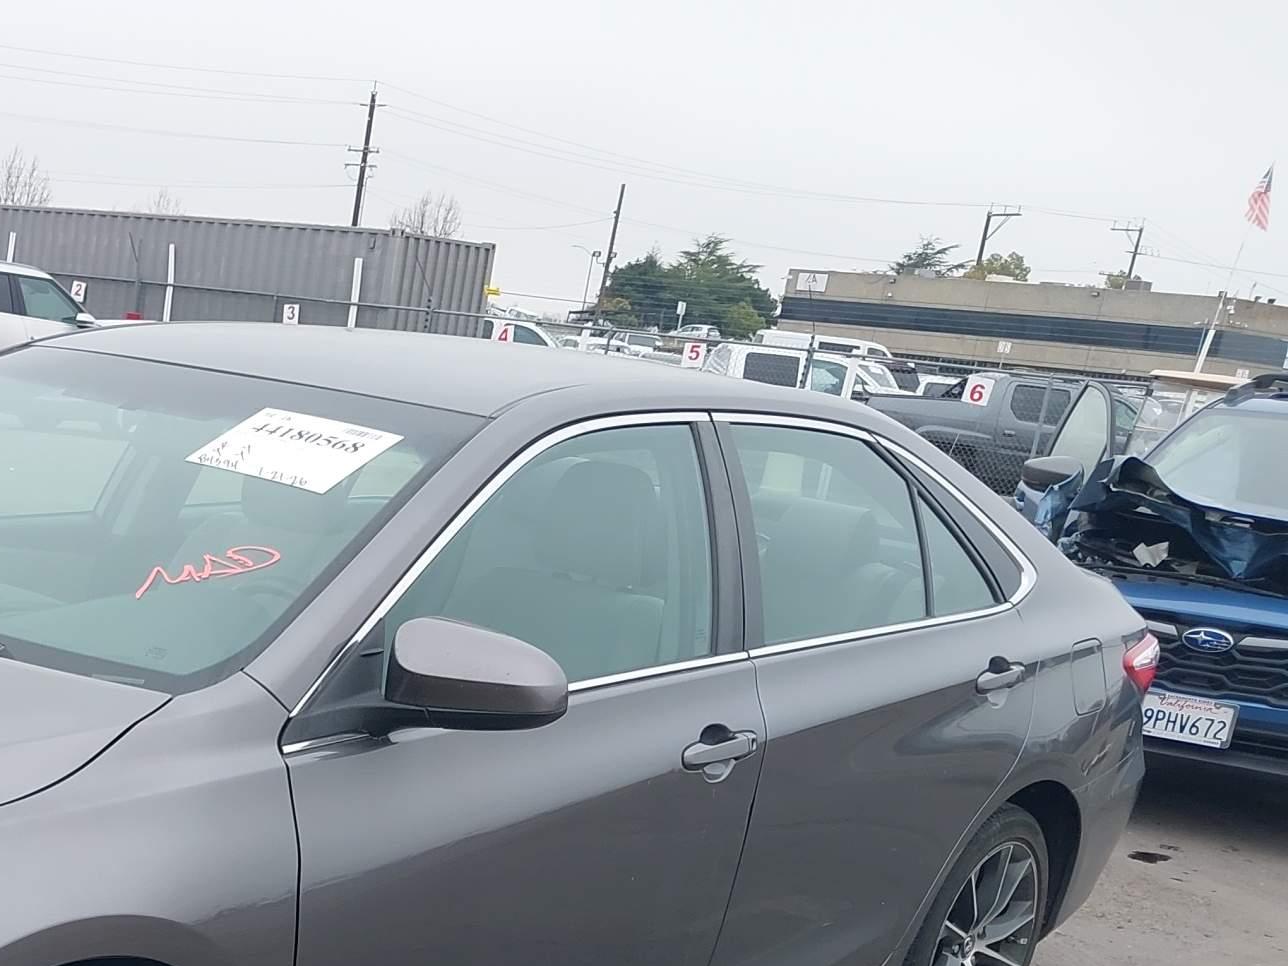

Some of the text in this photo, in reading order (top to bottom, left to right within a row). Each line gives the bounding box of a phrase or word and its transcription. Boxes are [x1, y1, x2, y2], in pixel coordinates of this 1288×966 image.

[74, 283, 82, 296] 2
[287, 306, 296, 320] 3
[498, 327, 509, 341] 4
[688, 344, 701, 360] 5
[970, 384, 985, 402] 6
[252, 423, 365, 454] 44180568
[1158, 694, 1217, 714] California
[1143, 708, 1226, 740] 9PHV672
